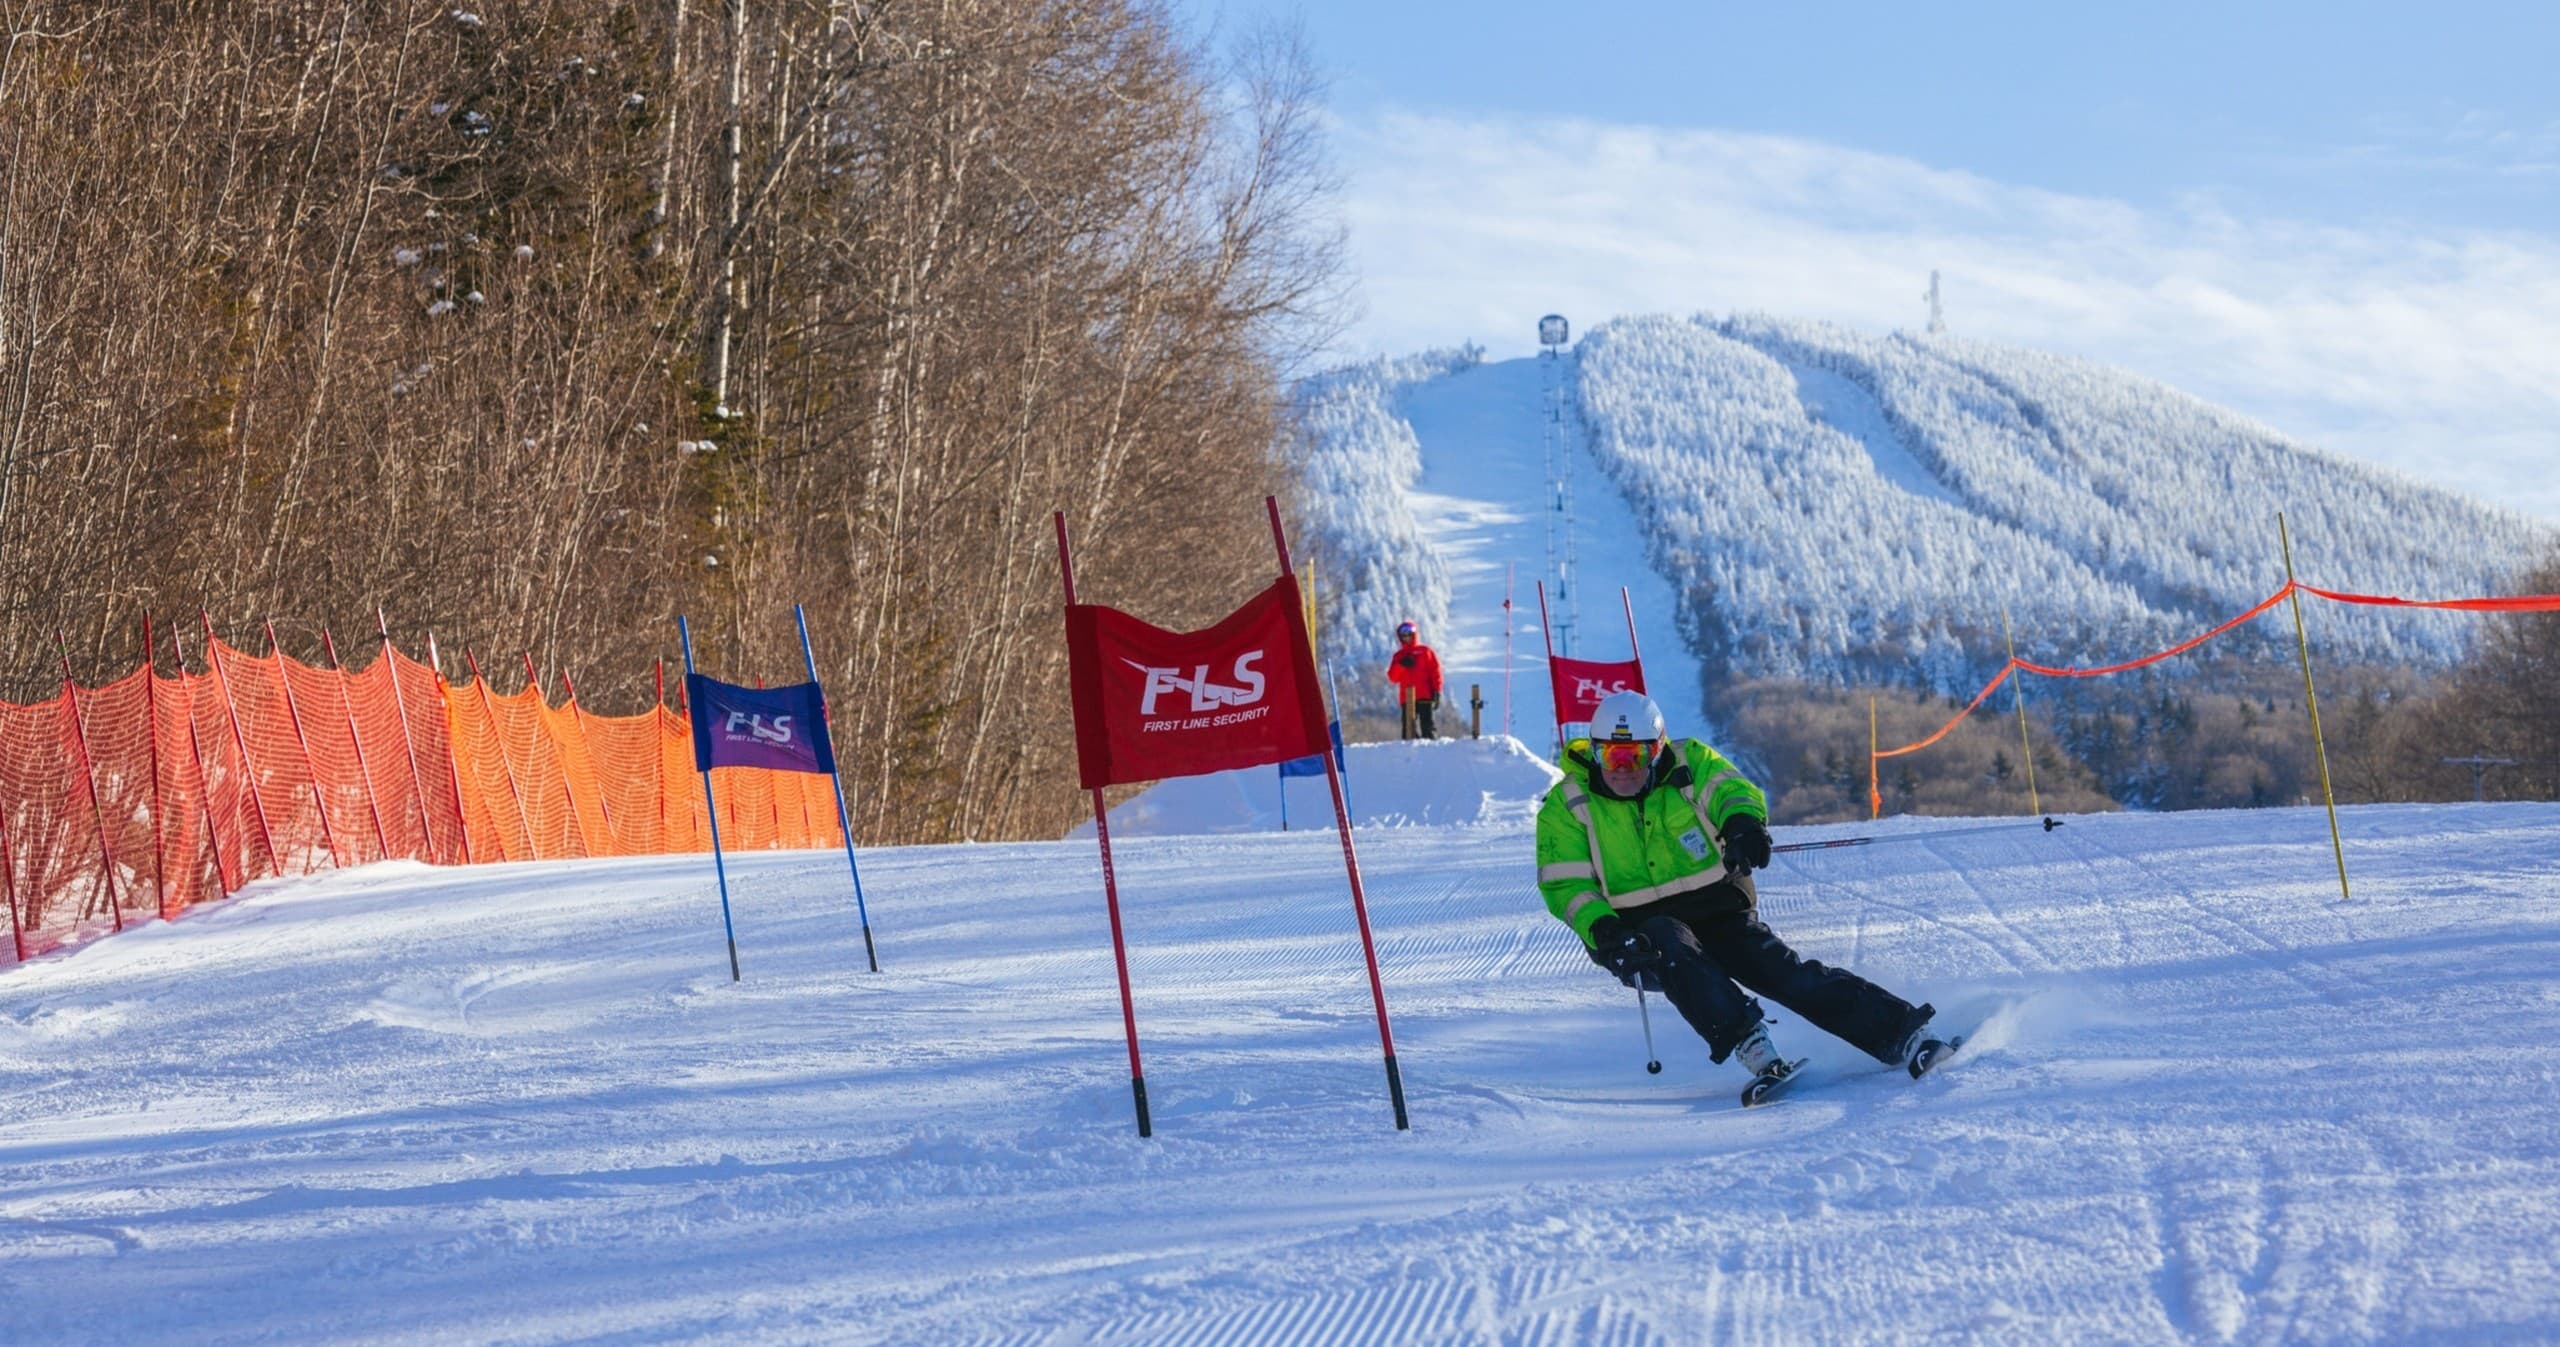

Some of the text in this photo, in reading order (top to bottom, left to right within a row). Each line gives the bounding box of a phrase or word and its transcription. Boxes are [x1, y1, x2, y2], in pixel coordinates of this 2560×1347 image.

[1138, 649, 1266, 715] FLS
[726, 711, 792, 742] FLS
[1143, 706, 1270, 733] FIRST LINE SECURITY
